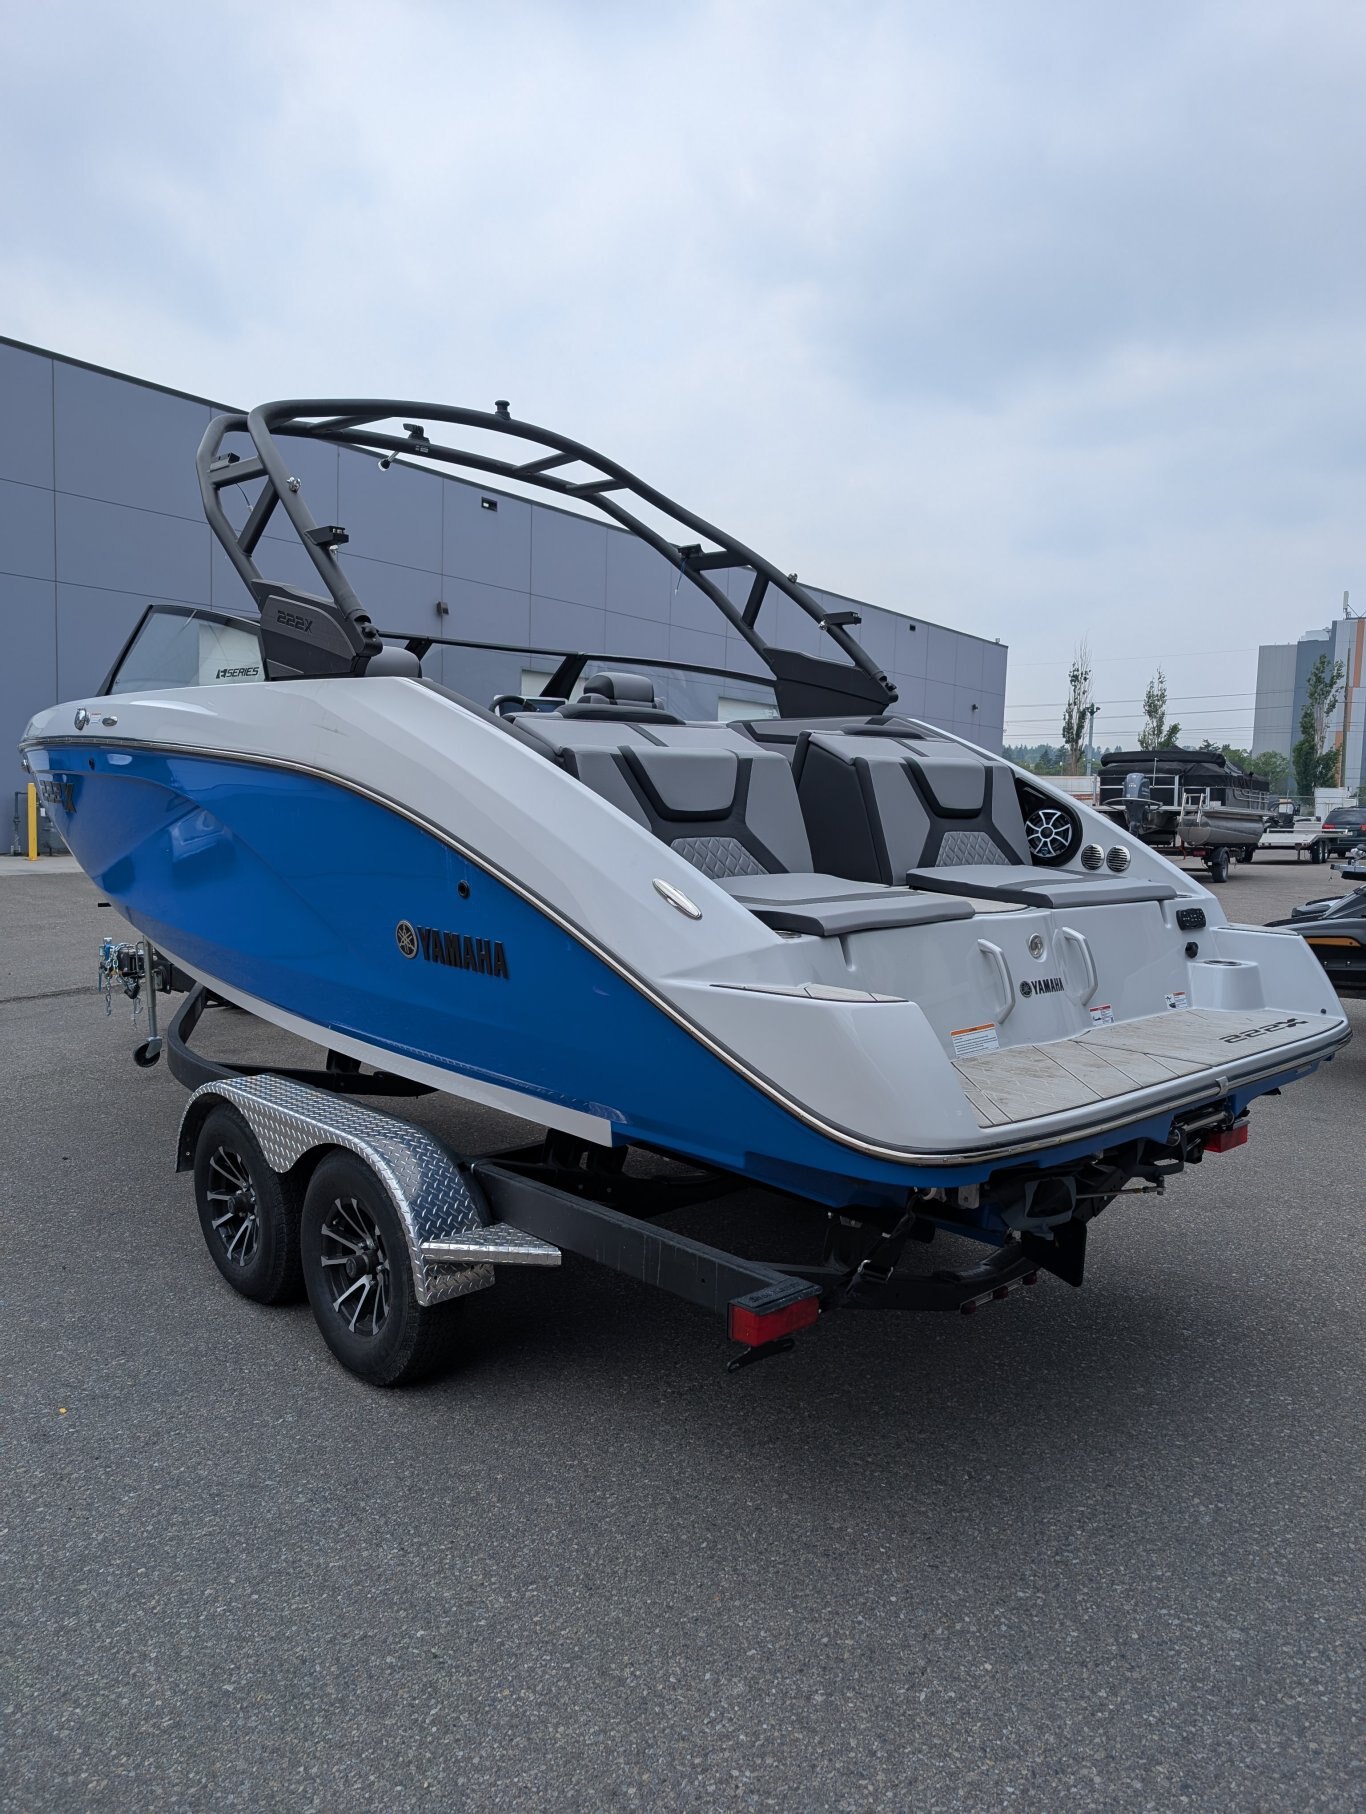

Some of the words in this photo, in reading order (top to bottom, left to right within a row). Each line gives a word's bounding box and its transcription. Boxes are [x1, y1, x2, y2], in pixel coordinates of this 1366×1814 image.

[277, 610, 312, 633] 222X
[416, 925, 510, 980] YAMAHA
[1030, 977, 1065, 995] YAMAHA
[1219, 1017, 1309, 1044] 222X
